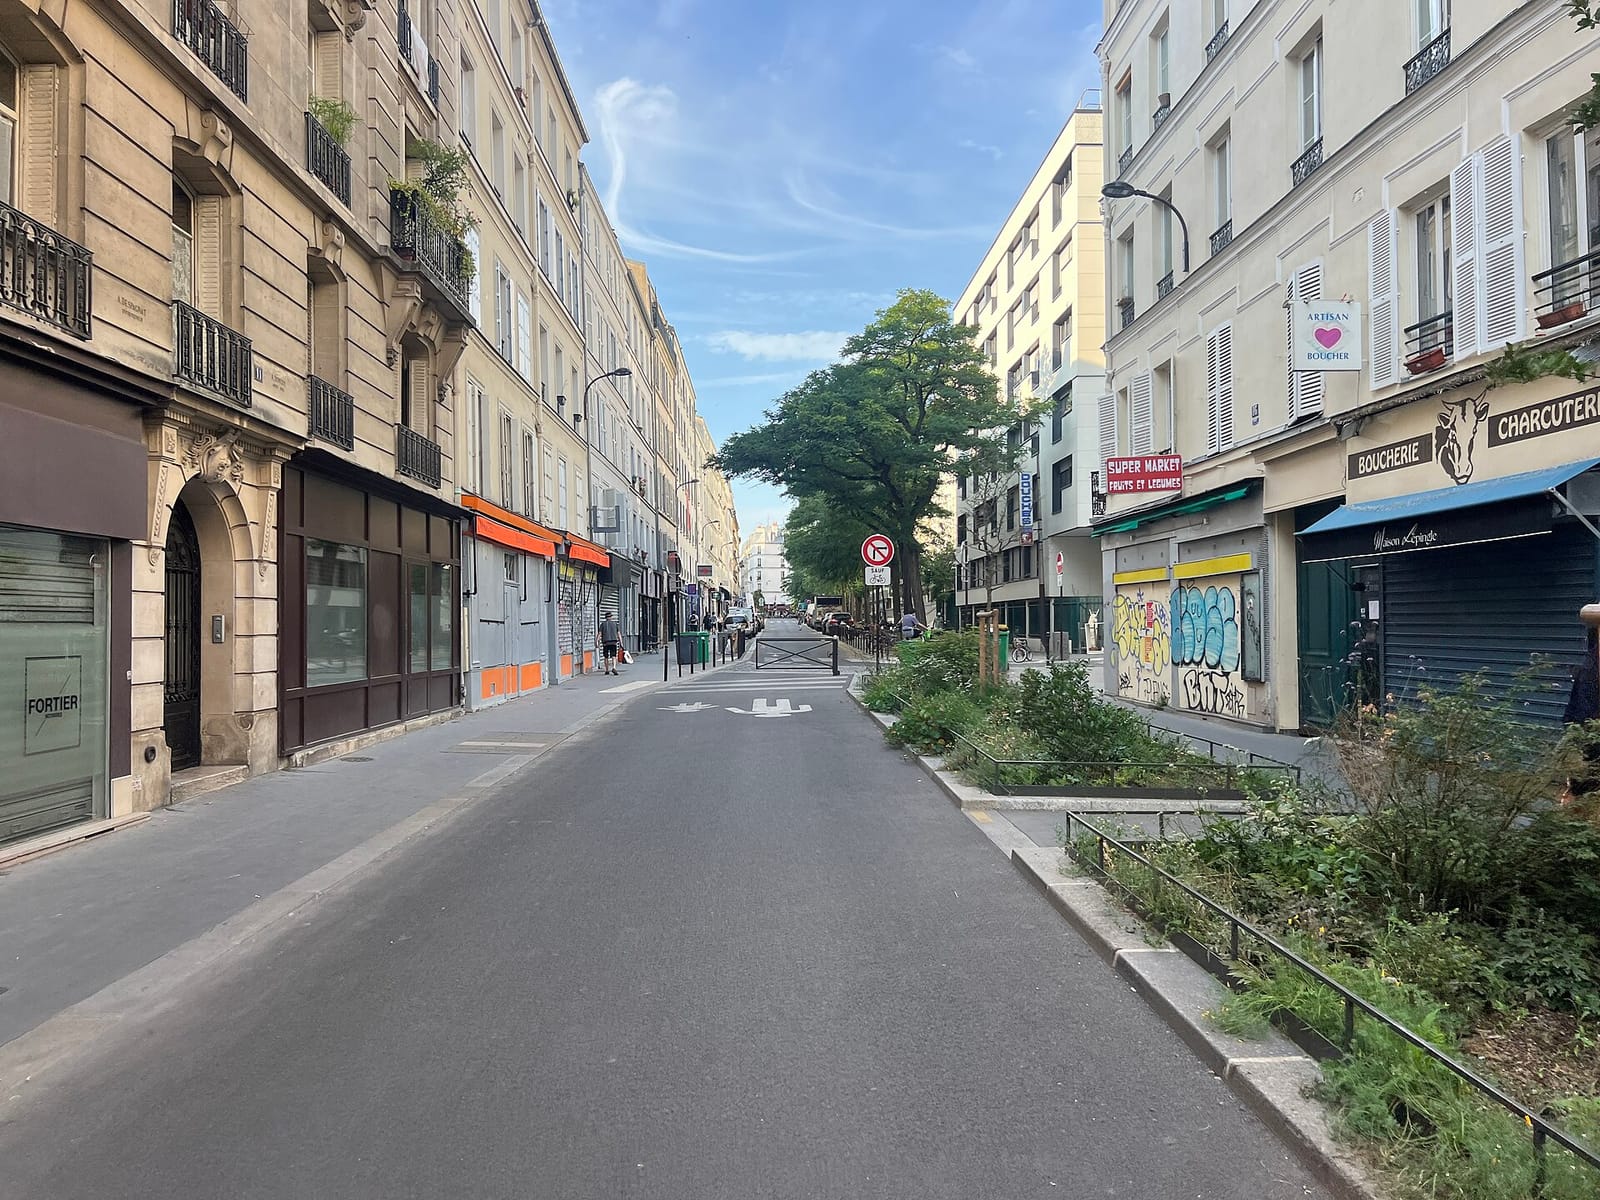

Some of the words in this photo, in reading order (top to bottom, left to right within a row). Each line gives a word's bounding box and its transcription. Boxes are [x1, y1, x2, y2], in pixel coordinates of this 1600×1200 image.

[1307, 313, 1349, 321] ARTISAN
[1307, 352, 1349, 360] BOUCHER
[1108, 461, 1141, 474] SUPER
[1145, 458, 1180, 472] MARKET
[1358, 441, 1419, 474] BOUCHERIE
[1136, 480, 1145, 490] ET
[1021, 473, 1031, 525] DOUCHES
[1373, 526, 1400, 551] Maison
[28, 695, 78, 714] FORTIER
